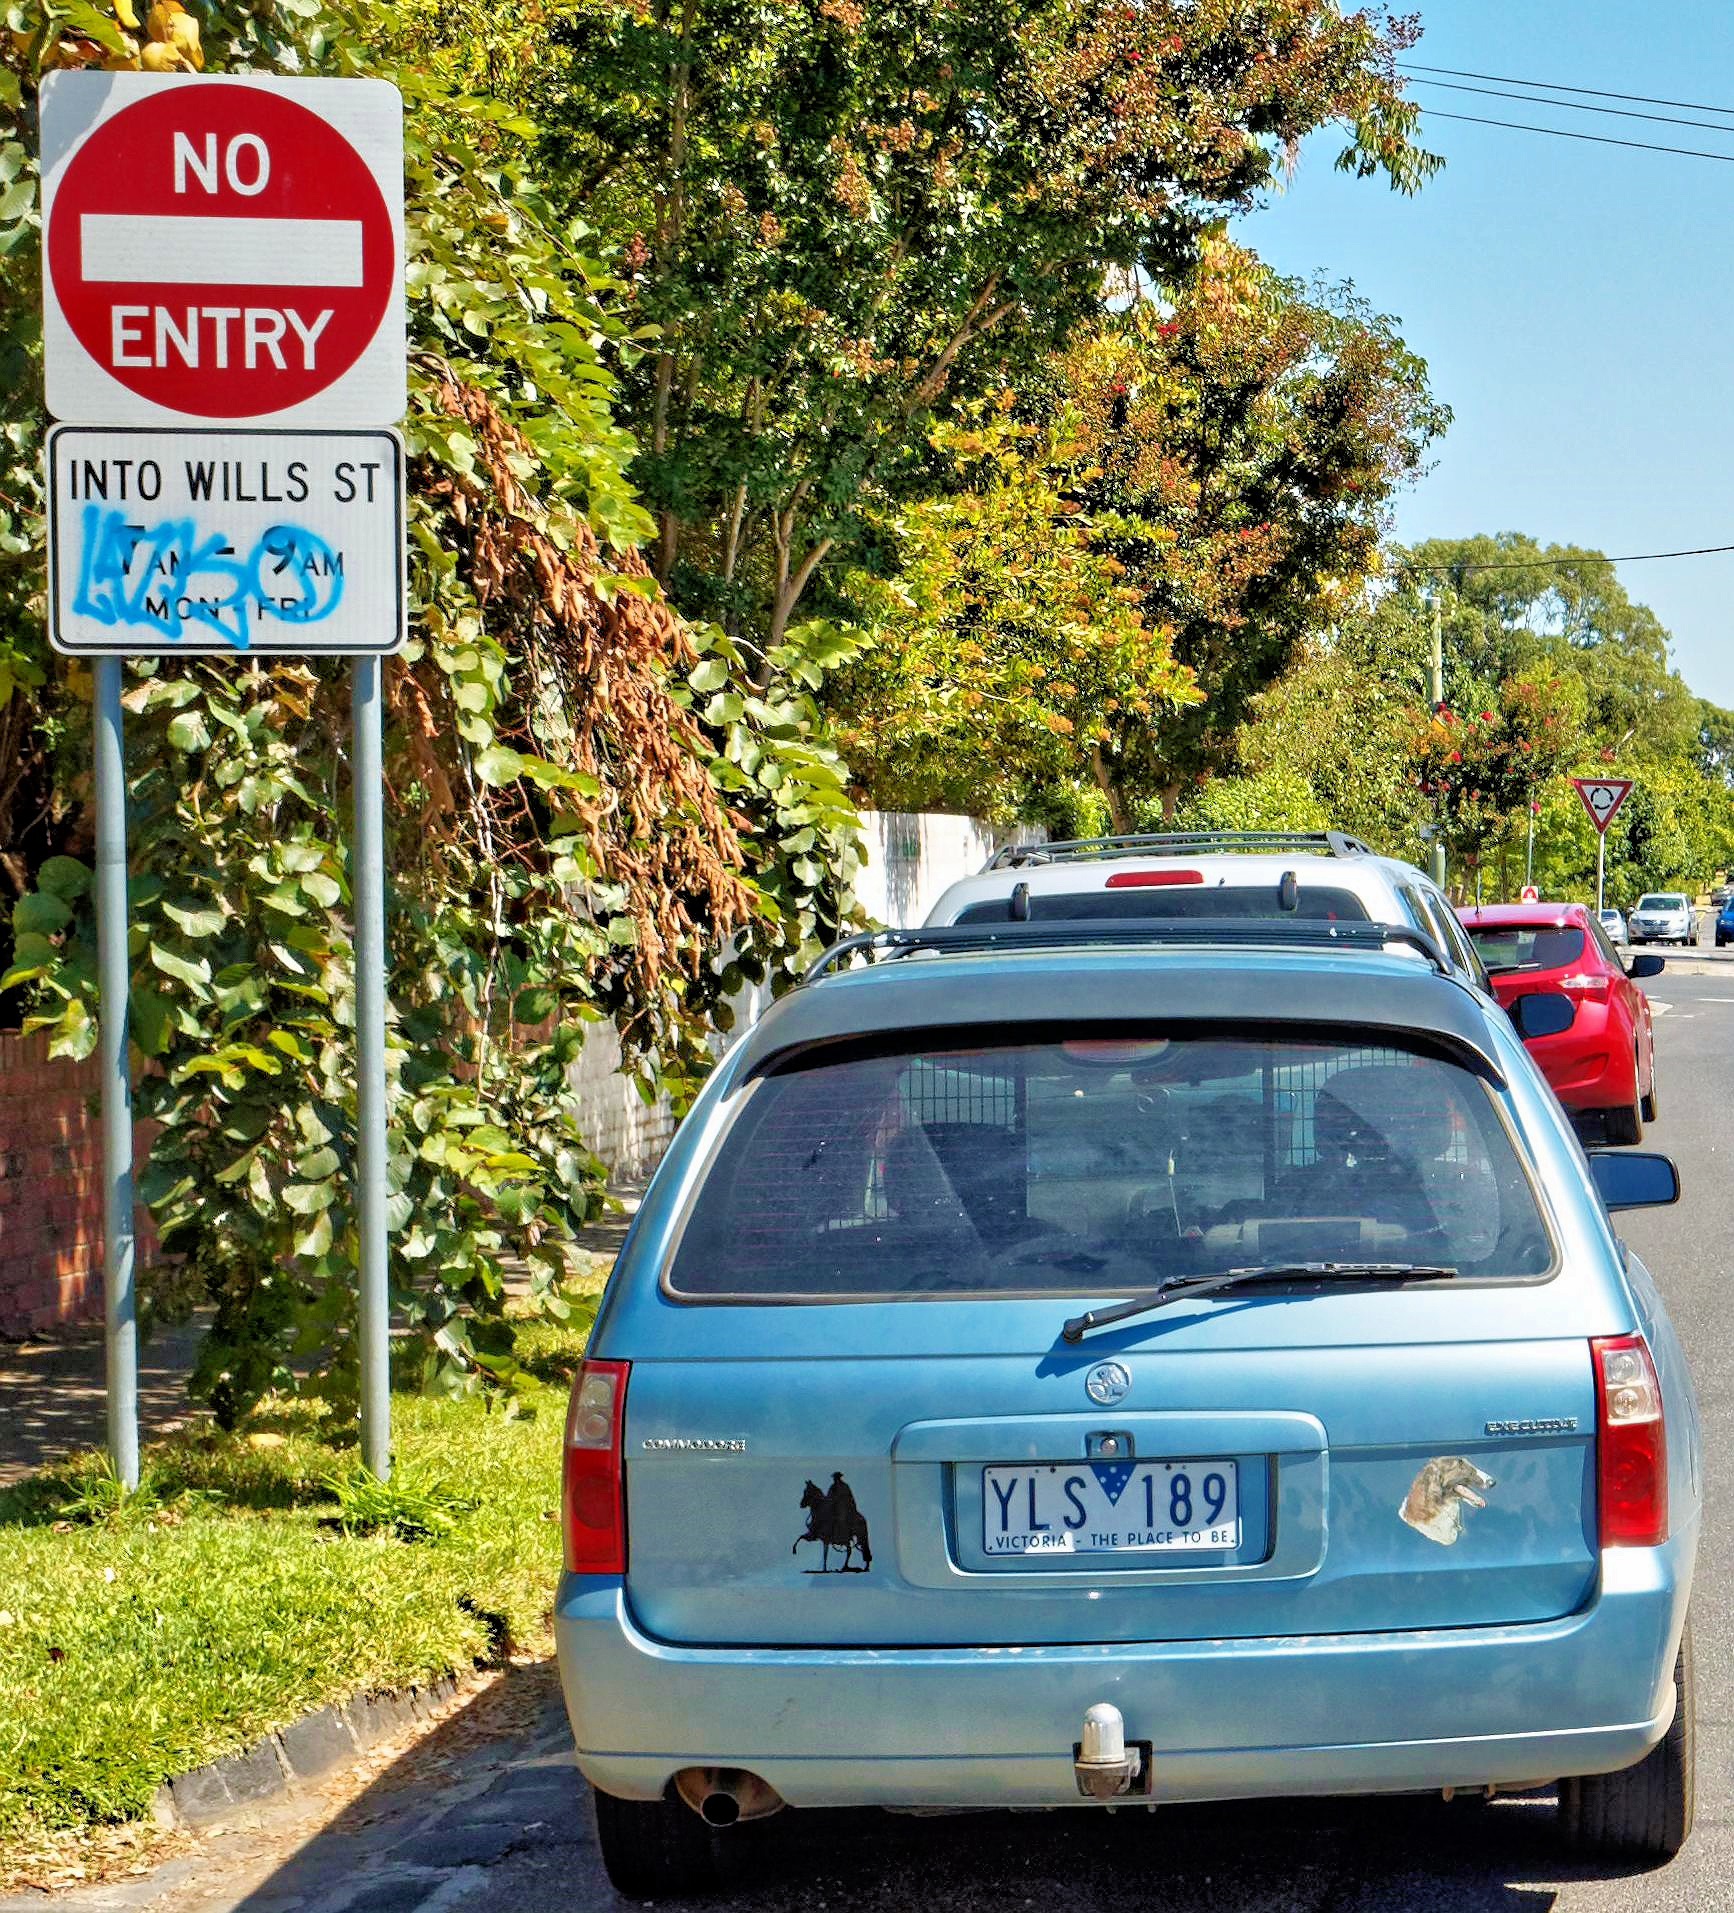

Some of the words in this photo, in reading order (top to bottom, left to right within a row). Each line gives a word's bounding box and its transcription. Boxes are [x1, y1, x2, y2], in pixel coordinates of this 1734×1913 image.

[173, 131, 271, 197] NO
[110, 304, 336, 371] ENTRY
[70, 459, 162, 501] INTO
[184, 460, 310, 503] WILLS
[334, 461, 381, 504] ST
[641, 1438, 746, 1452] COMMODORE
[990, 1475, 1088, 1532] YLS
[1141, 1472, 1227, 1528] 189
[995, 1530, 1067, 1549] VICTORIA
[1090, 1532, 1119, 1546] THE
[1128, 1531, 1174, 1546] PLACE
[1181, 1530, 1202, 1545] TO
[1210, 1529, 1229, 1544] BE
